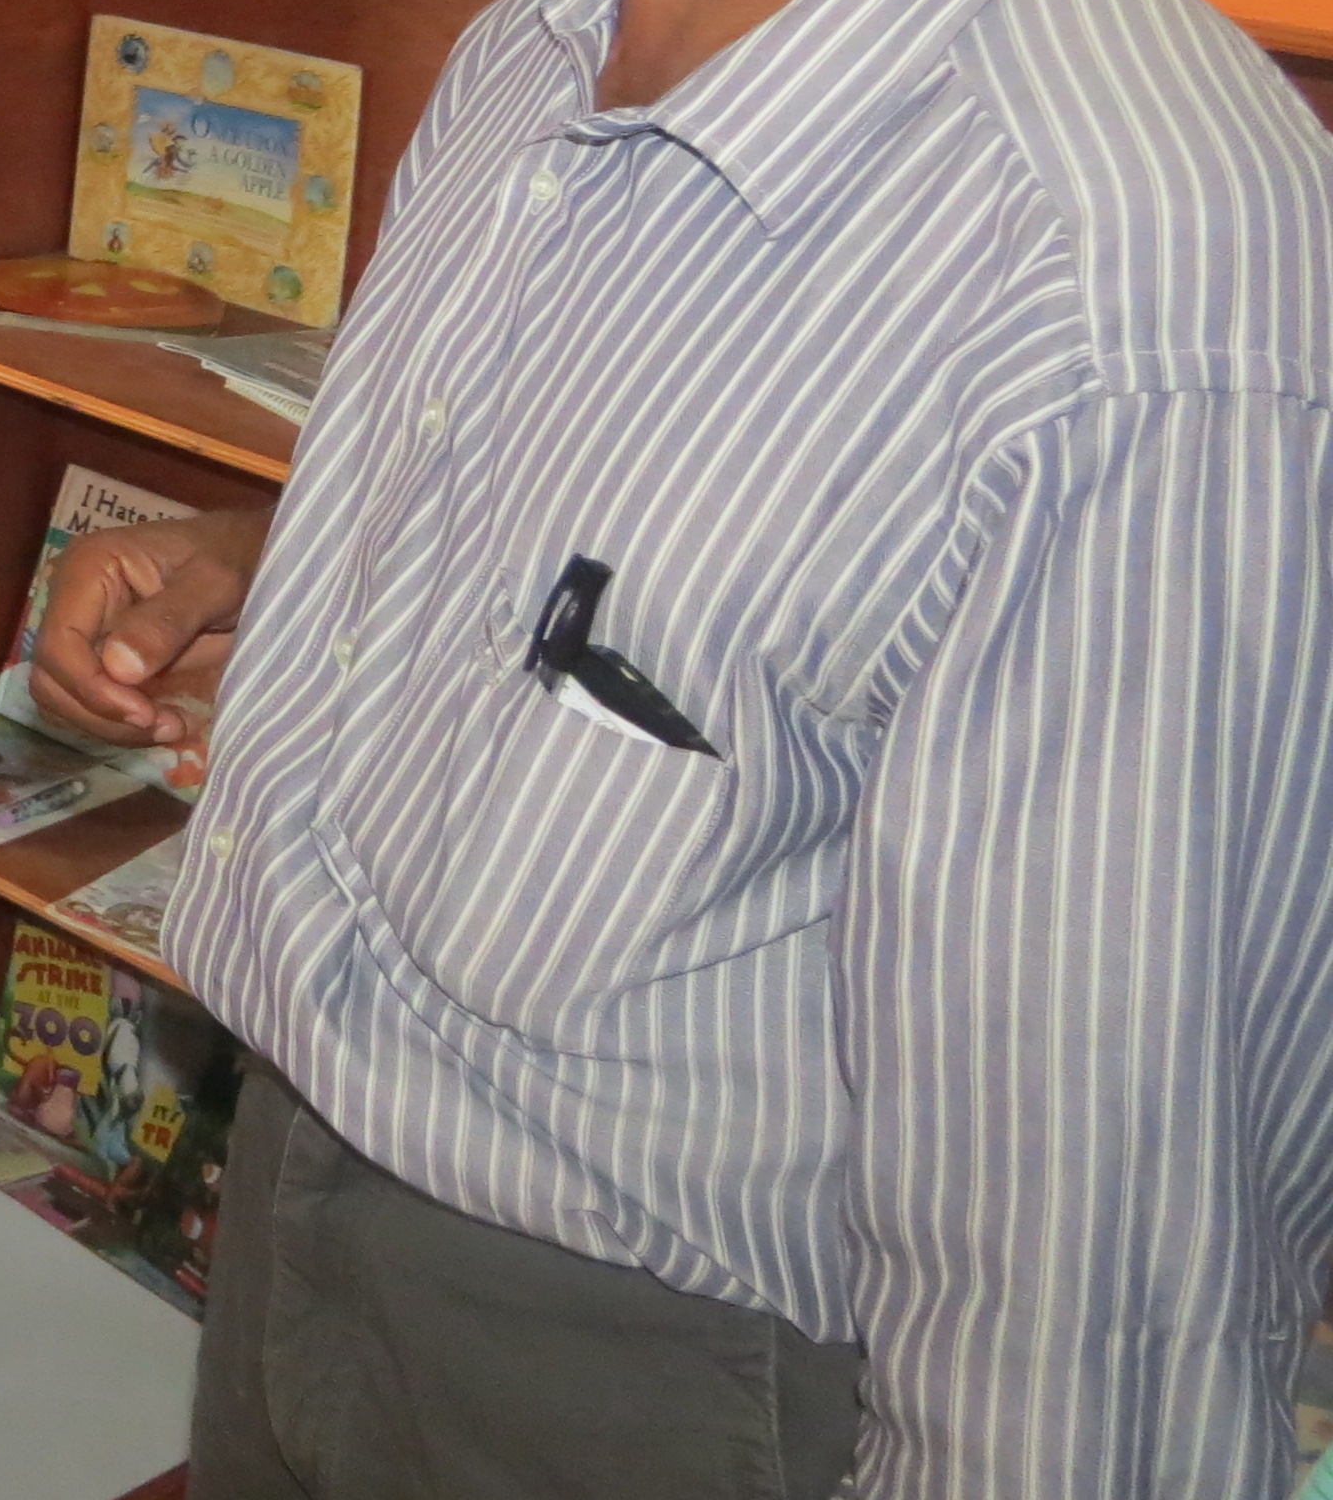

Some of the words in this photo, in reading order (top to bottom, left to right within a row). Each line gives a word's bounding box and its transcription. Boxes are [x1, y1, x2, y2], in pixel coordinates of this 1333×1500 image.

[81, 484, 94, 508] I
[95, 489, 149, 525] Hate
[16, 962, 103, 997] STRIKE
